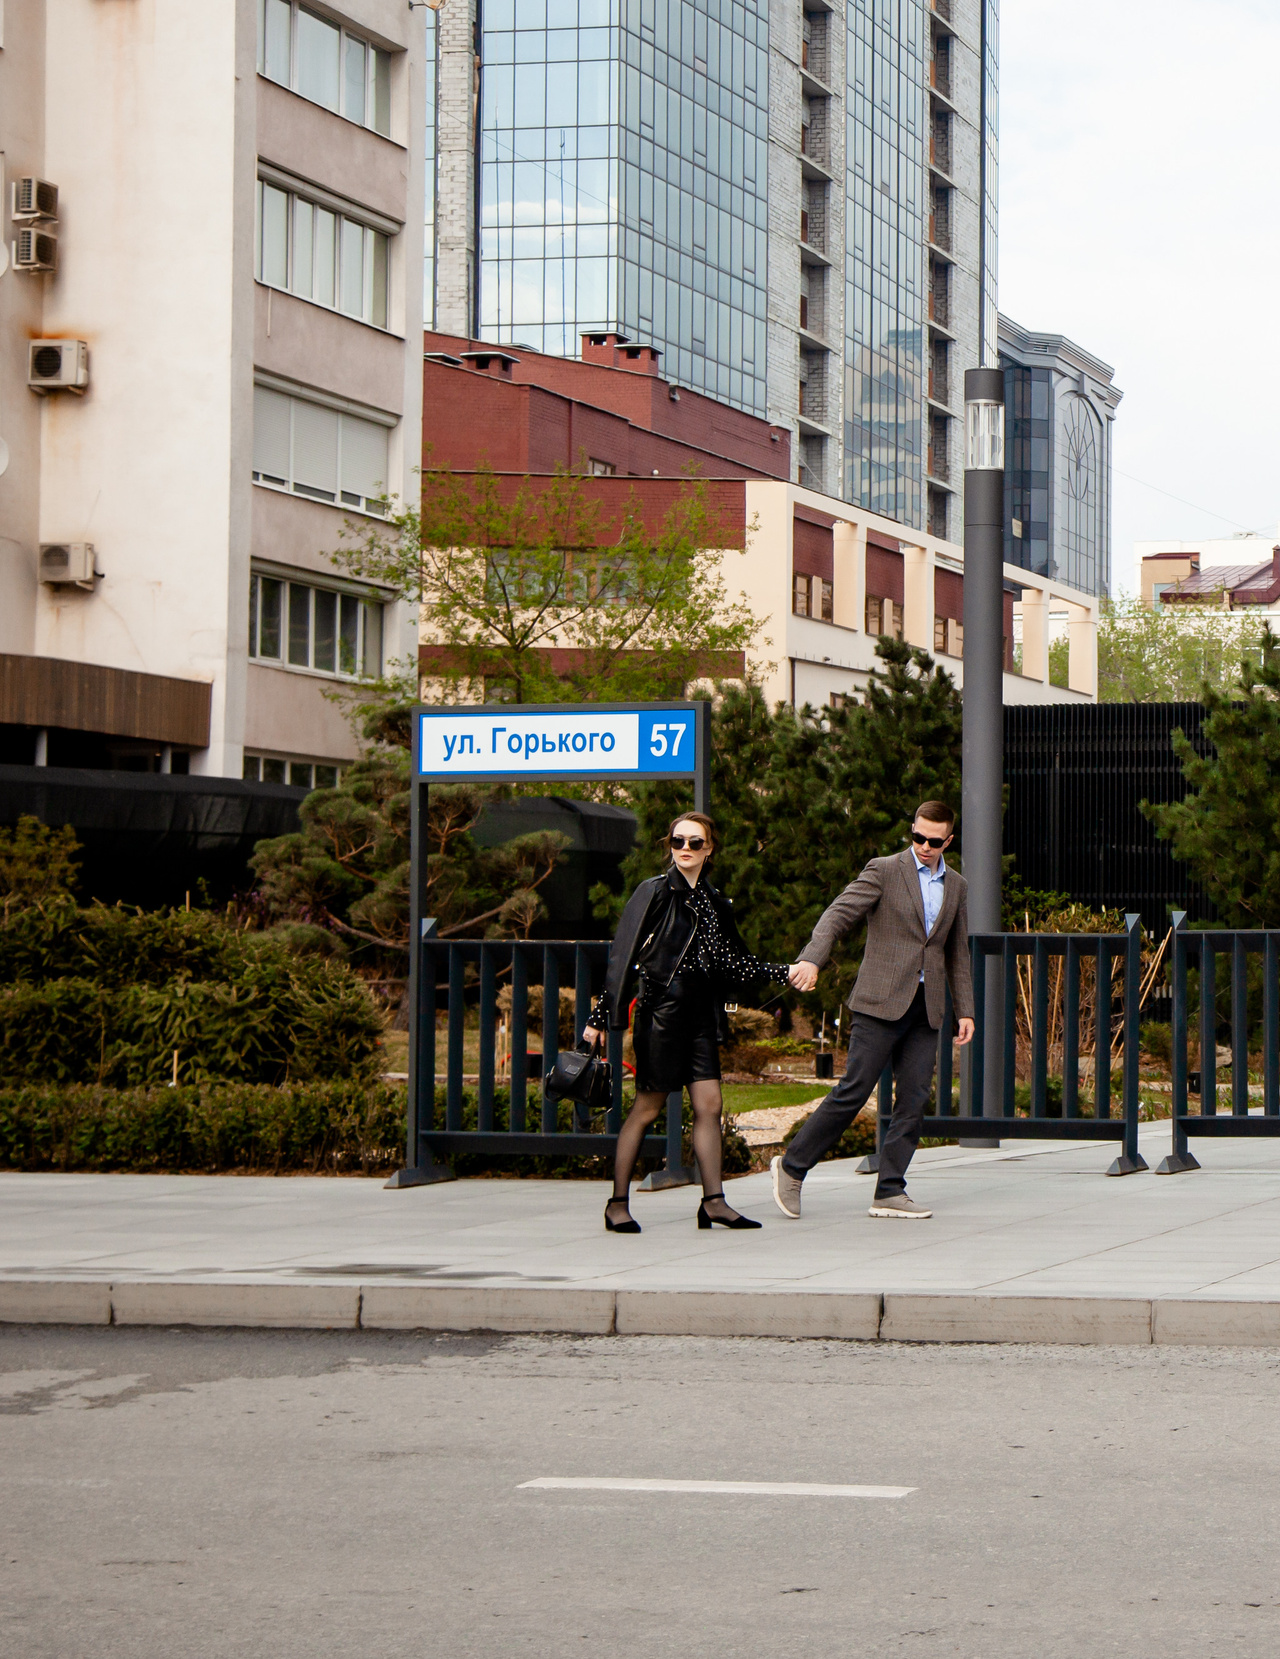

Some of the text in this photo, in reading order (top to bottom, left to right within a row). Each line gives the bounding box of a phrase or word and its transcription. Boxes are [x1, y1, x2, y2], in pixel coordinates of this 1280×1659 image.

[443, 723, 687, 761] ул. Горького 57
